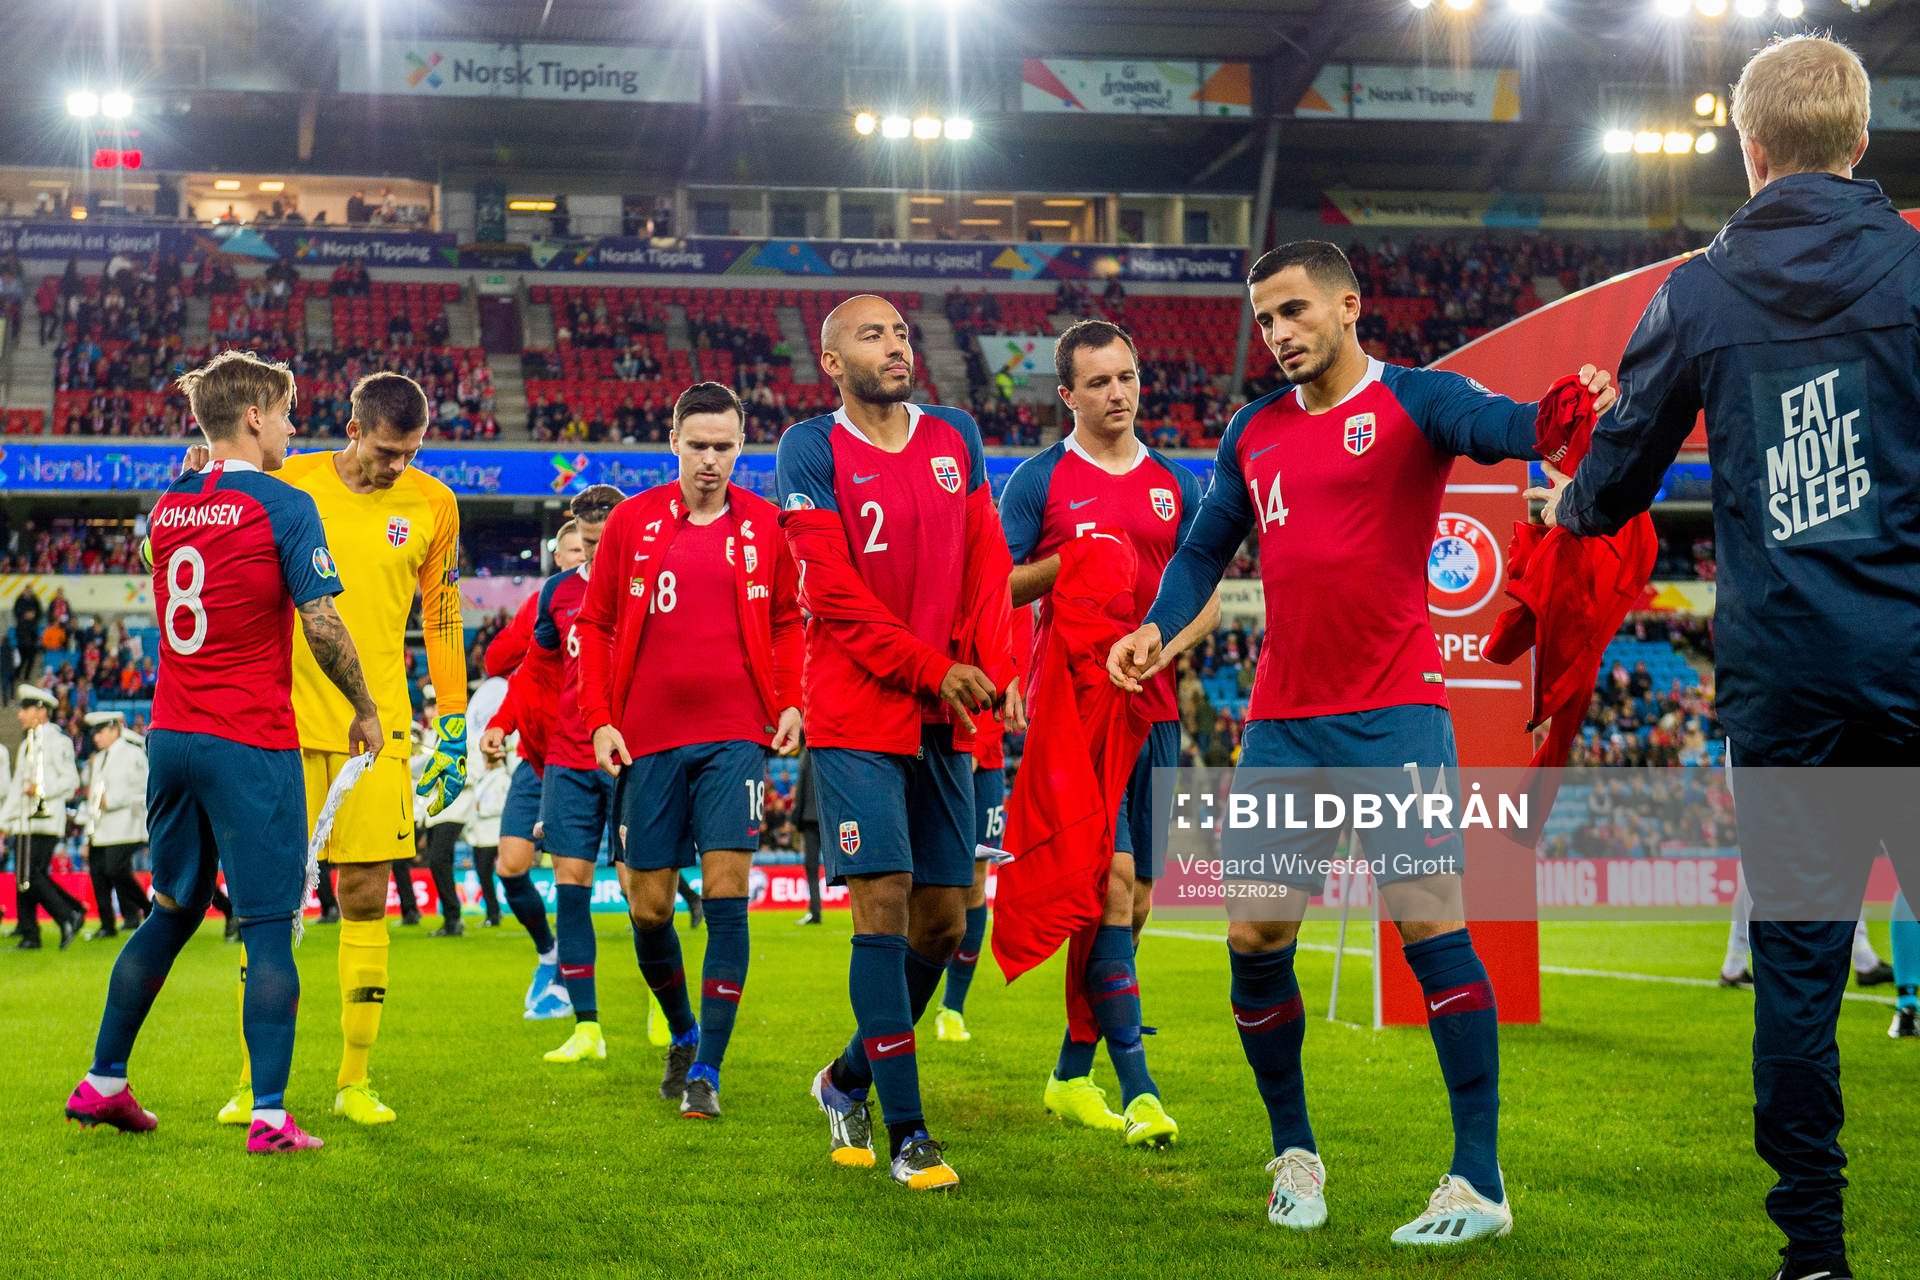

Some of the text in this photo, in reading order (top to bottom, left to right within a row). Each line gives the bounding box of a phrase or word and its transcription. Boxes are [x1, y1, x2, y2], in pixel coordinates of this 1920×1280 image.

[453, 59, 639, 94] Norsk Tipping
[1368, 86, 1475, 108] Norsk Tipping
[321, 240, 431, 263] Norsk Tipping
[1781, 368, 1840, 439] EAT
[18, 453, 103, 483] Norsk
[1766, 408, 1866, 495] MOVE
[155, 504, 244, 528] JOHANSEN
[1250, 470, 1290, 534] 14
[1768, 468, 1871, 541] SLEEP
[860, 500, 889, 554] 2
[1437, 520, 1479, 545] EFA
[165, 545, 208, 656] 8
[566, 623, 580, 658] 6
[745, 779, 765, 821] 18
[985, 805, 1004, 839] 15
[1606, 860, 1735, 907] NORGE-
